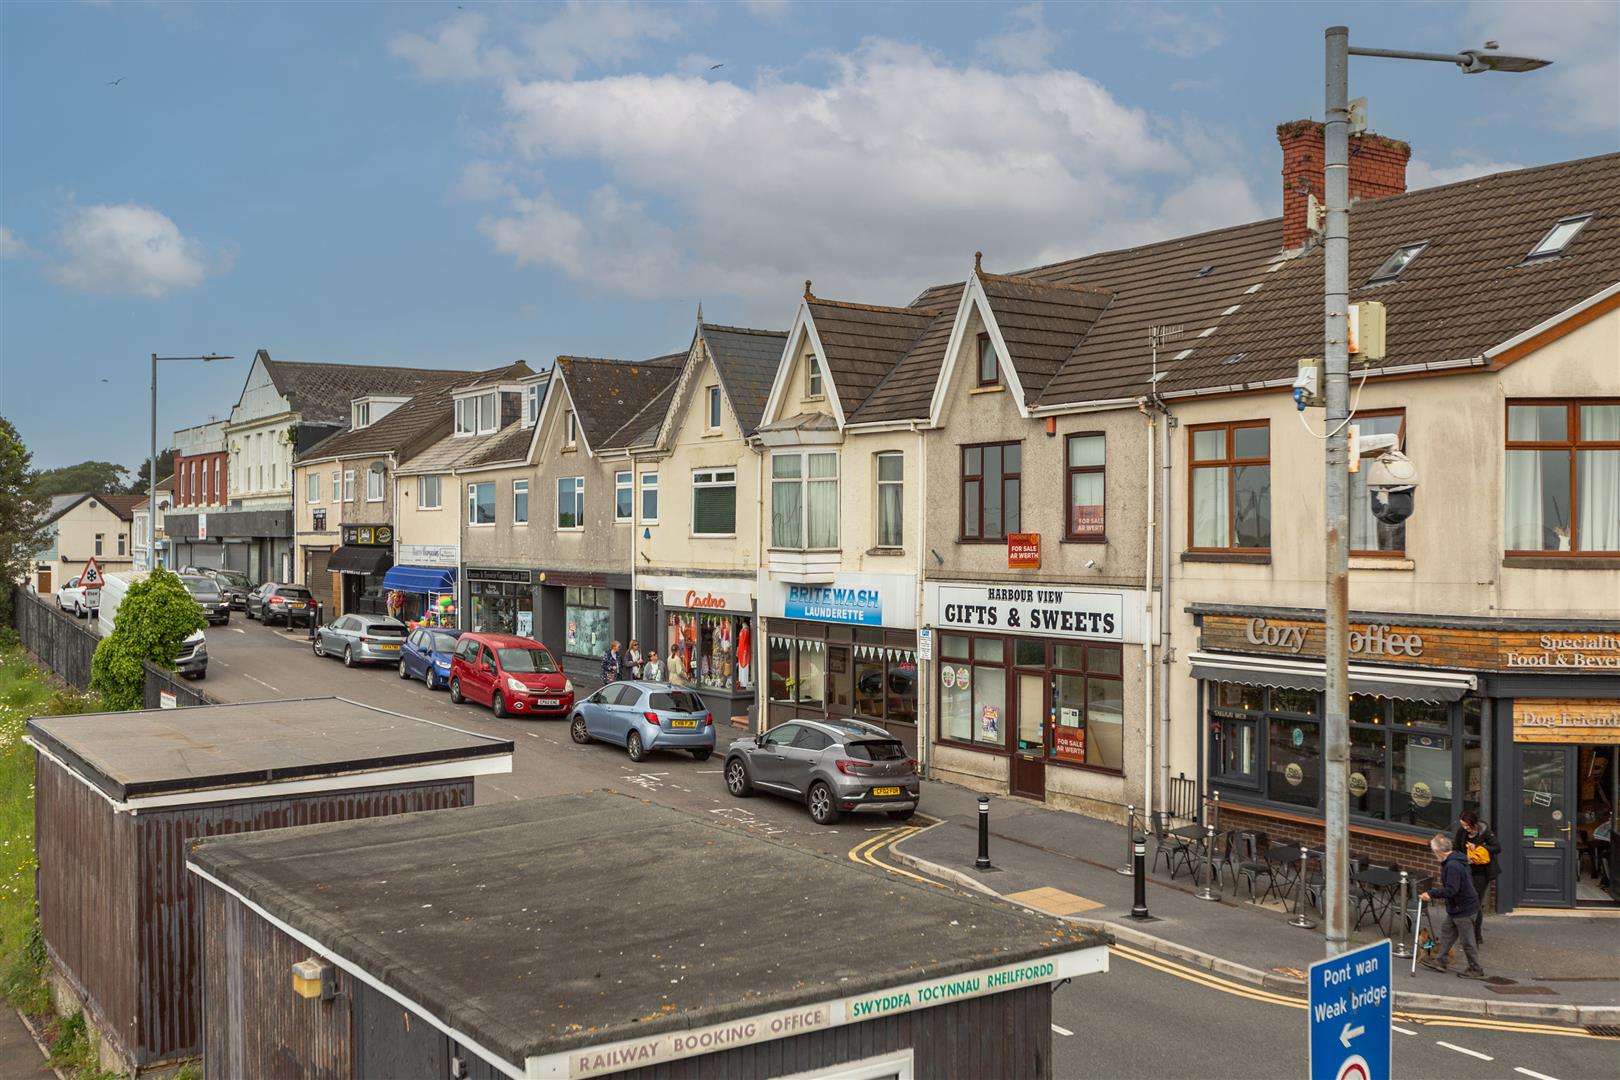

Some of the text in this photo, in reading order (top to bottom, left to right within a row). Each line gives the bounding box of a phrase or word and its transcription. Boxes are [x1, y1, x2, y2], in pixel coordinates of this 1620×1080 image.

[988, 588, 1063, 604] HARBOUR VIEW
[804, 606, 864, 620] LAUNDERETTE
[944, 604, 1115, 634] GIFTS & SWEETS
[1246, 618, 1424, 657] Cozy offee
[1507, 652, 1550, 668] Food
[1556, 654, 1568, 668] &
[1522, 712, 1556, 728] Dog
[1065, 746, 1085, 755] WERTH
[1324, 958, 1378, 988] Pont wan
[853, 963, 1054, 1016] SWYDDFA TOCYNNAU RHEILFFORDD
[1314, 986, 1387, 1023] Weak bridge
[579, 1010, 821, 1072] RAILWAY BOOKING OFFICE
